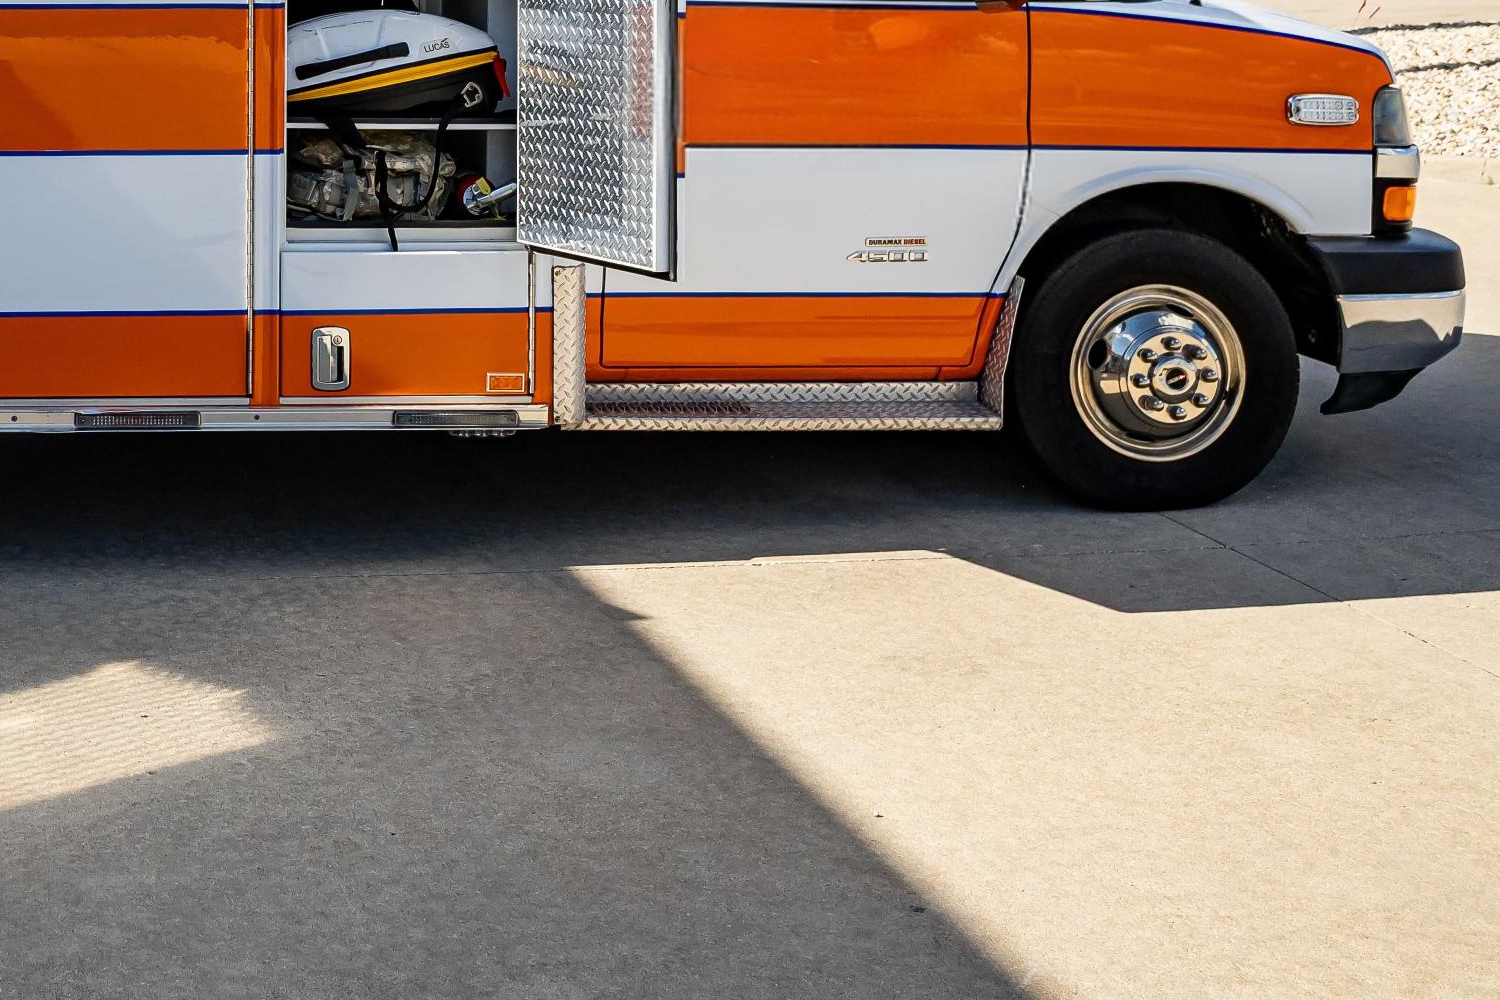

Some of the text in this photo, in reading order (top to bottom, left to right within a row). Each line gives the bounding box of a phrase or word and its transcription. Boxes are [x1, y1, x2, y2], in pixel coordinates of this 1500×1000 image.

[423, 39, 450, 53] LUCAS
[868, 238, 902, 246] DURAMAX
[846, 249, 928, 263] 4500
